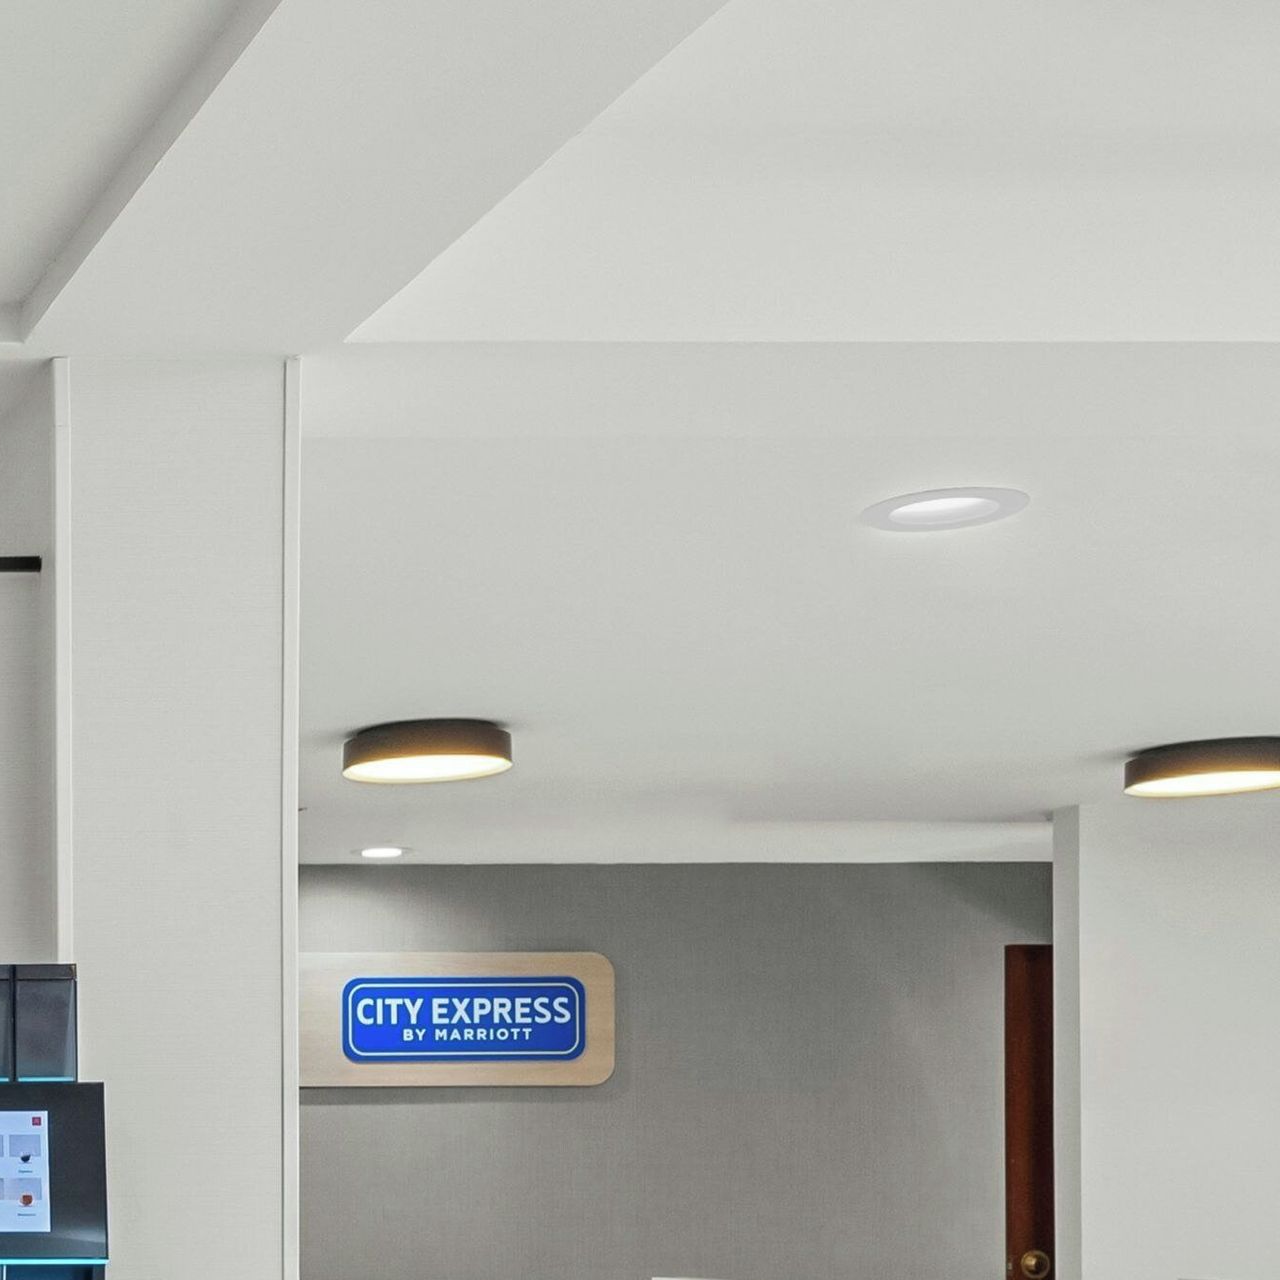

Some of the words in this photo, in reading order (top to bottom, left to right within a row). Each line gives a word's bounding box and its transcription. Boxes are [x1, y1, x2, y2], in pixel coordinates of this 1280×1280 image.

[356, 997, 423, 1025] CITY
[432, 996, 571, 1024] EXPRESS
[402, 1028, 426, 1041] BY
[435, 1027, 532, 1041] MARRIOTT
